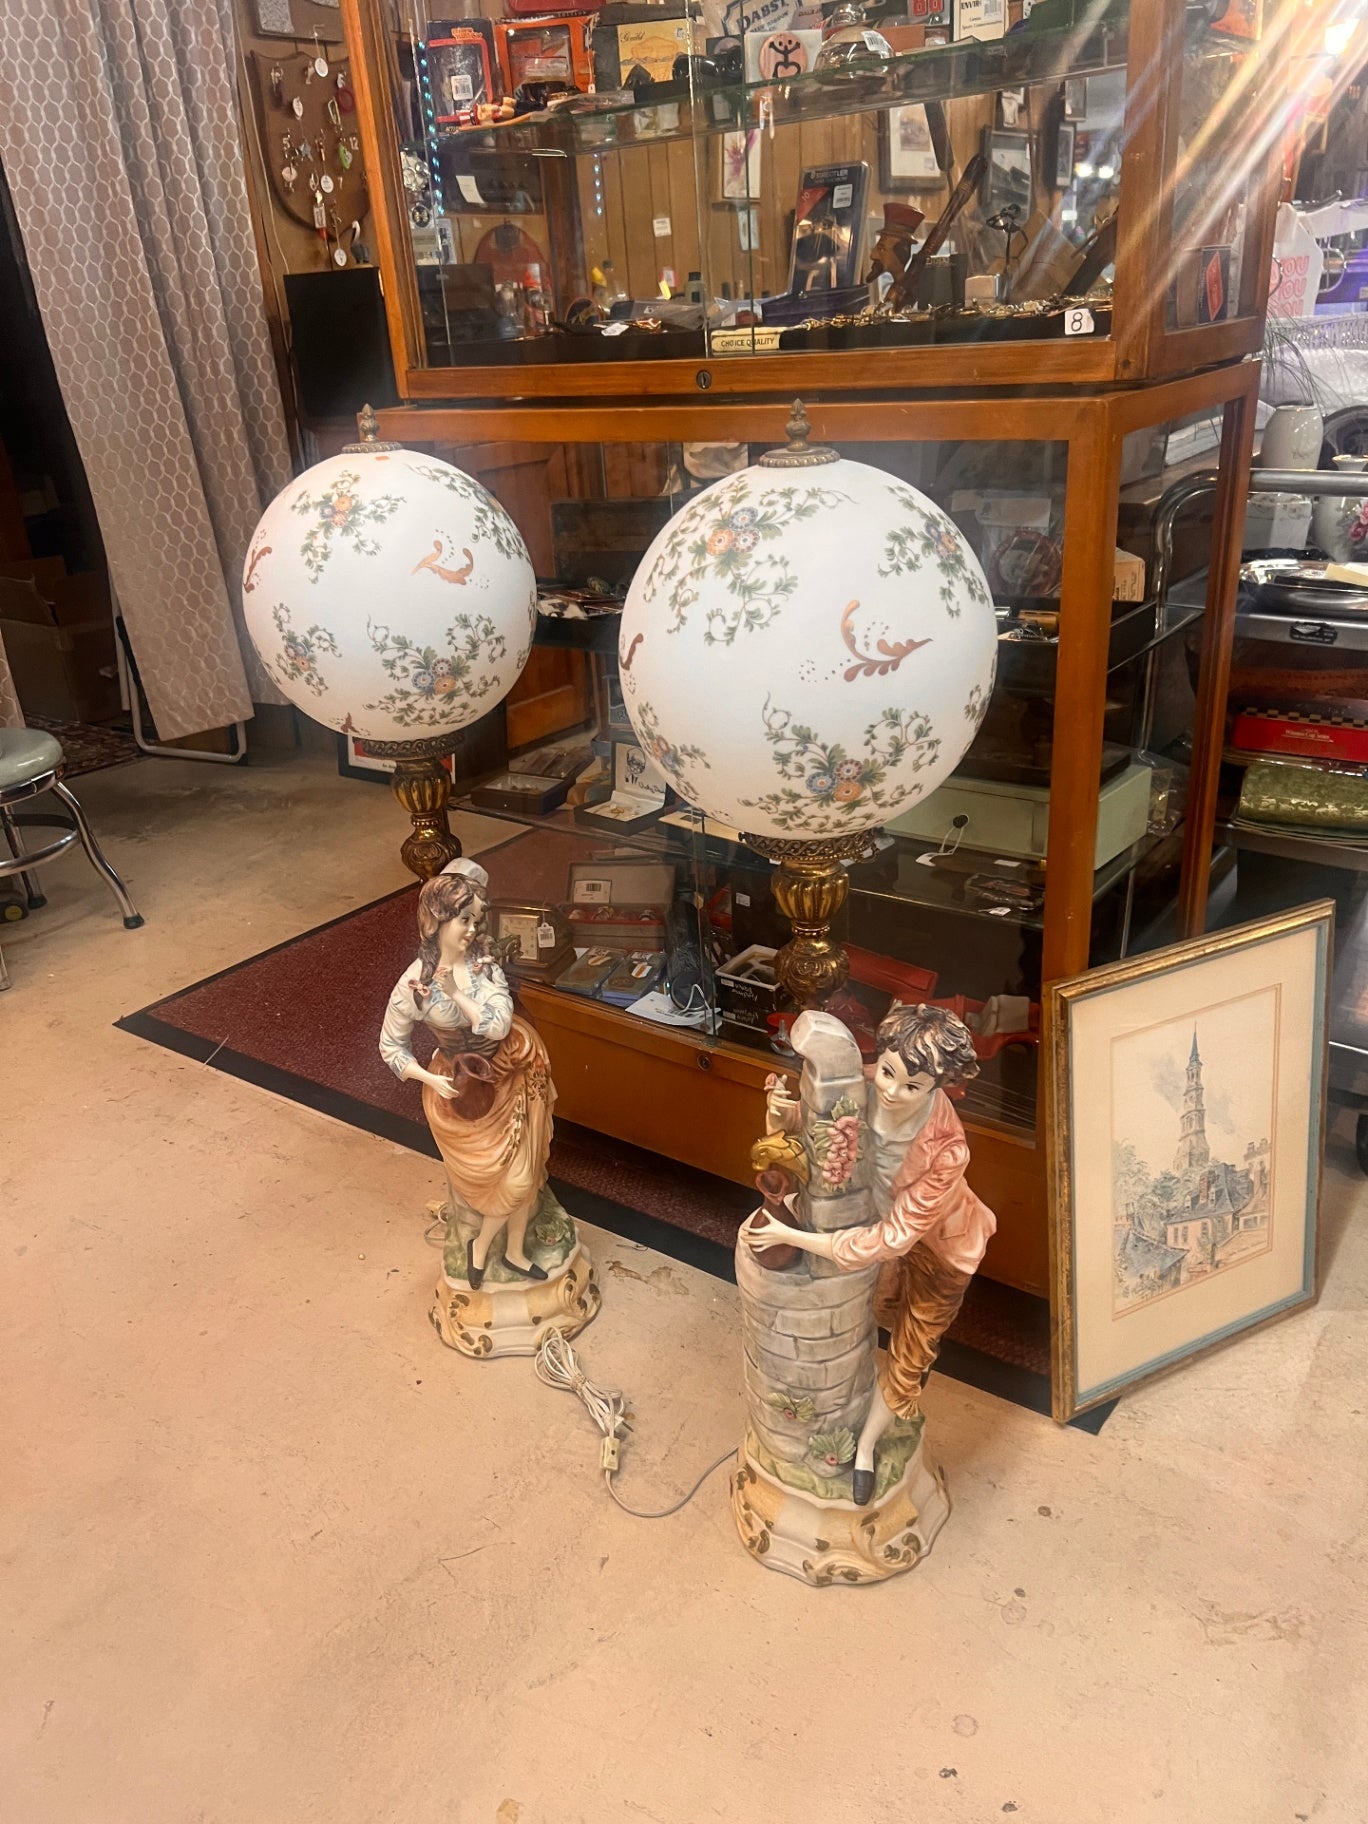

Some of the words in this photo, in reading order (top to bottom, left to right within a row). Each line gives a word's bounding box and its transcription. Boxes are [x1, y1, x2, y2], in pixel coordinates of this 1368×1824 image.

[349, 137, 359, 150] 12
[1071, 312, 1083, 332] 8
[721, 340, 745, 348] CHOICE
[746, 338, 775, 347] QALITY
